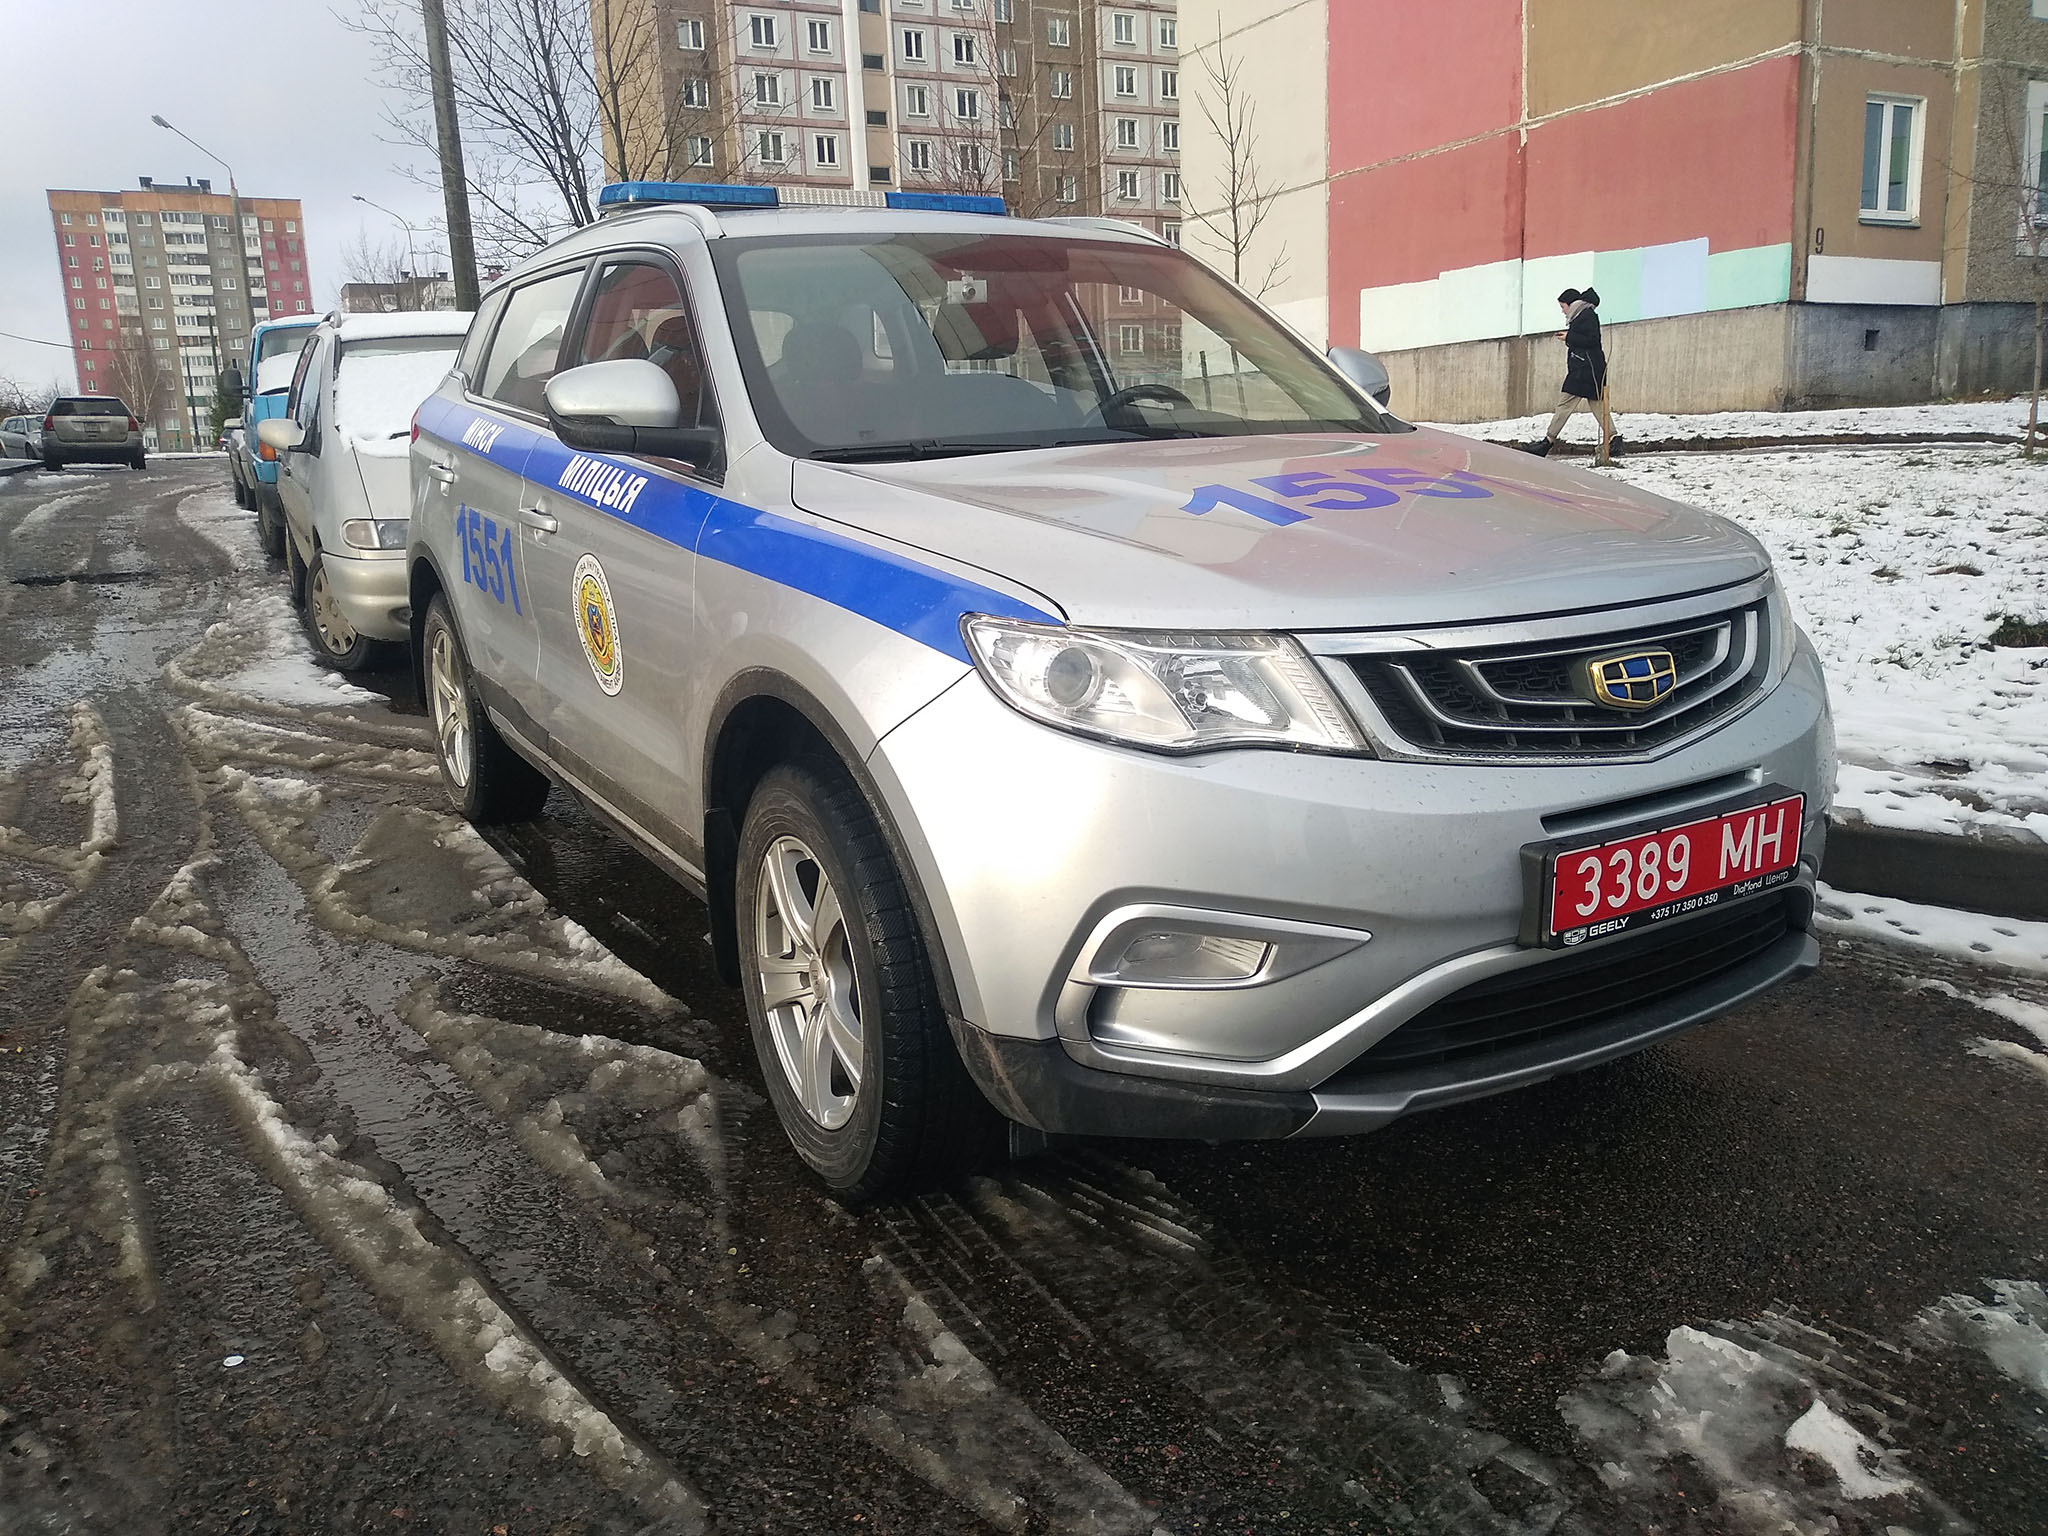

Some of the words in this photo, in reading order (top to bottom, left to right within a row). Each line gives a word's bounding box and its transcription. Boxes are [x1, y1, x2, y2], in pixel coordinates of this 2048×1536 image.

[1815, 227, 1825, 254] 9
[461, 417, 505, 454] МІНСК
[558, 454, 649, 514] МІЛІЦЫЯ
[456, 502, 523, 616] 1551
[1575, 834, 1691, 917] 3389
[1765, 870, 1789, 885] Центр
[1650, 907, 1670, 920] +375
[1671, 904, 1681, 916] 17
[1682, 900, 1697, 912] 350
[1703, 892, 1719, 905] 350
[1589, 916, 1630, 937] GEELY
